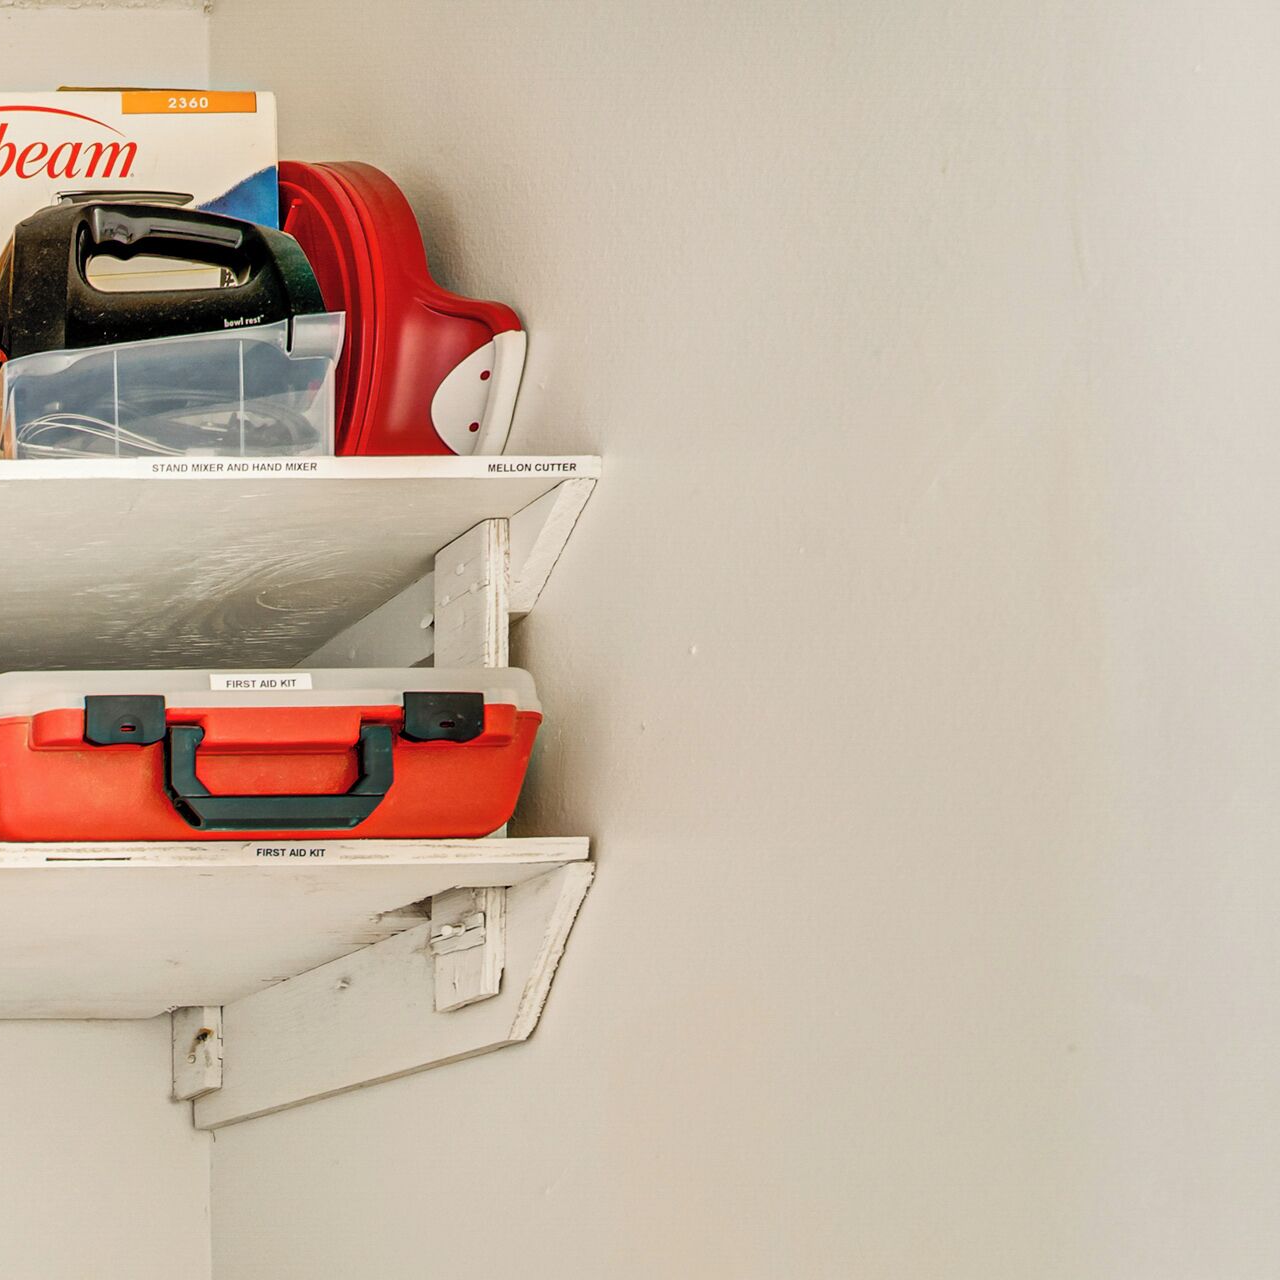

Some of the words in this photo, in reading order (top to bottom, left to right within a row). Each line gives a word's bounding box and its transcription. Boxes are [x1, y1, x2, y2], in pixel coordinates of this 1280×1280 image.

[168, 97, 209, 109] 2360
[224, 316, 243, 328] bowl
[152, 463, 188, 472] STAND
[191, 463, 224, 472] MIXER
[227, 463, 249, 472] AND
[252, 462, 282, 472] HAND
[285, 462, 318, 471] MIXER
[487, 463, 532, 472] MELLON
[534, 462, 577, 472] CUTTER
[226, 679, 256, 688] FIRST
[260, 679, 277, 688] AID
[280, 679, 297, 687] KIT
[256, 848, 287, 857] FIRST
[289, 848, 307, 857] AID
[309, 848, 326, 857] KIT
